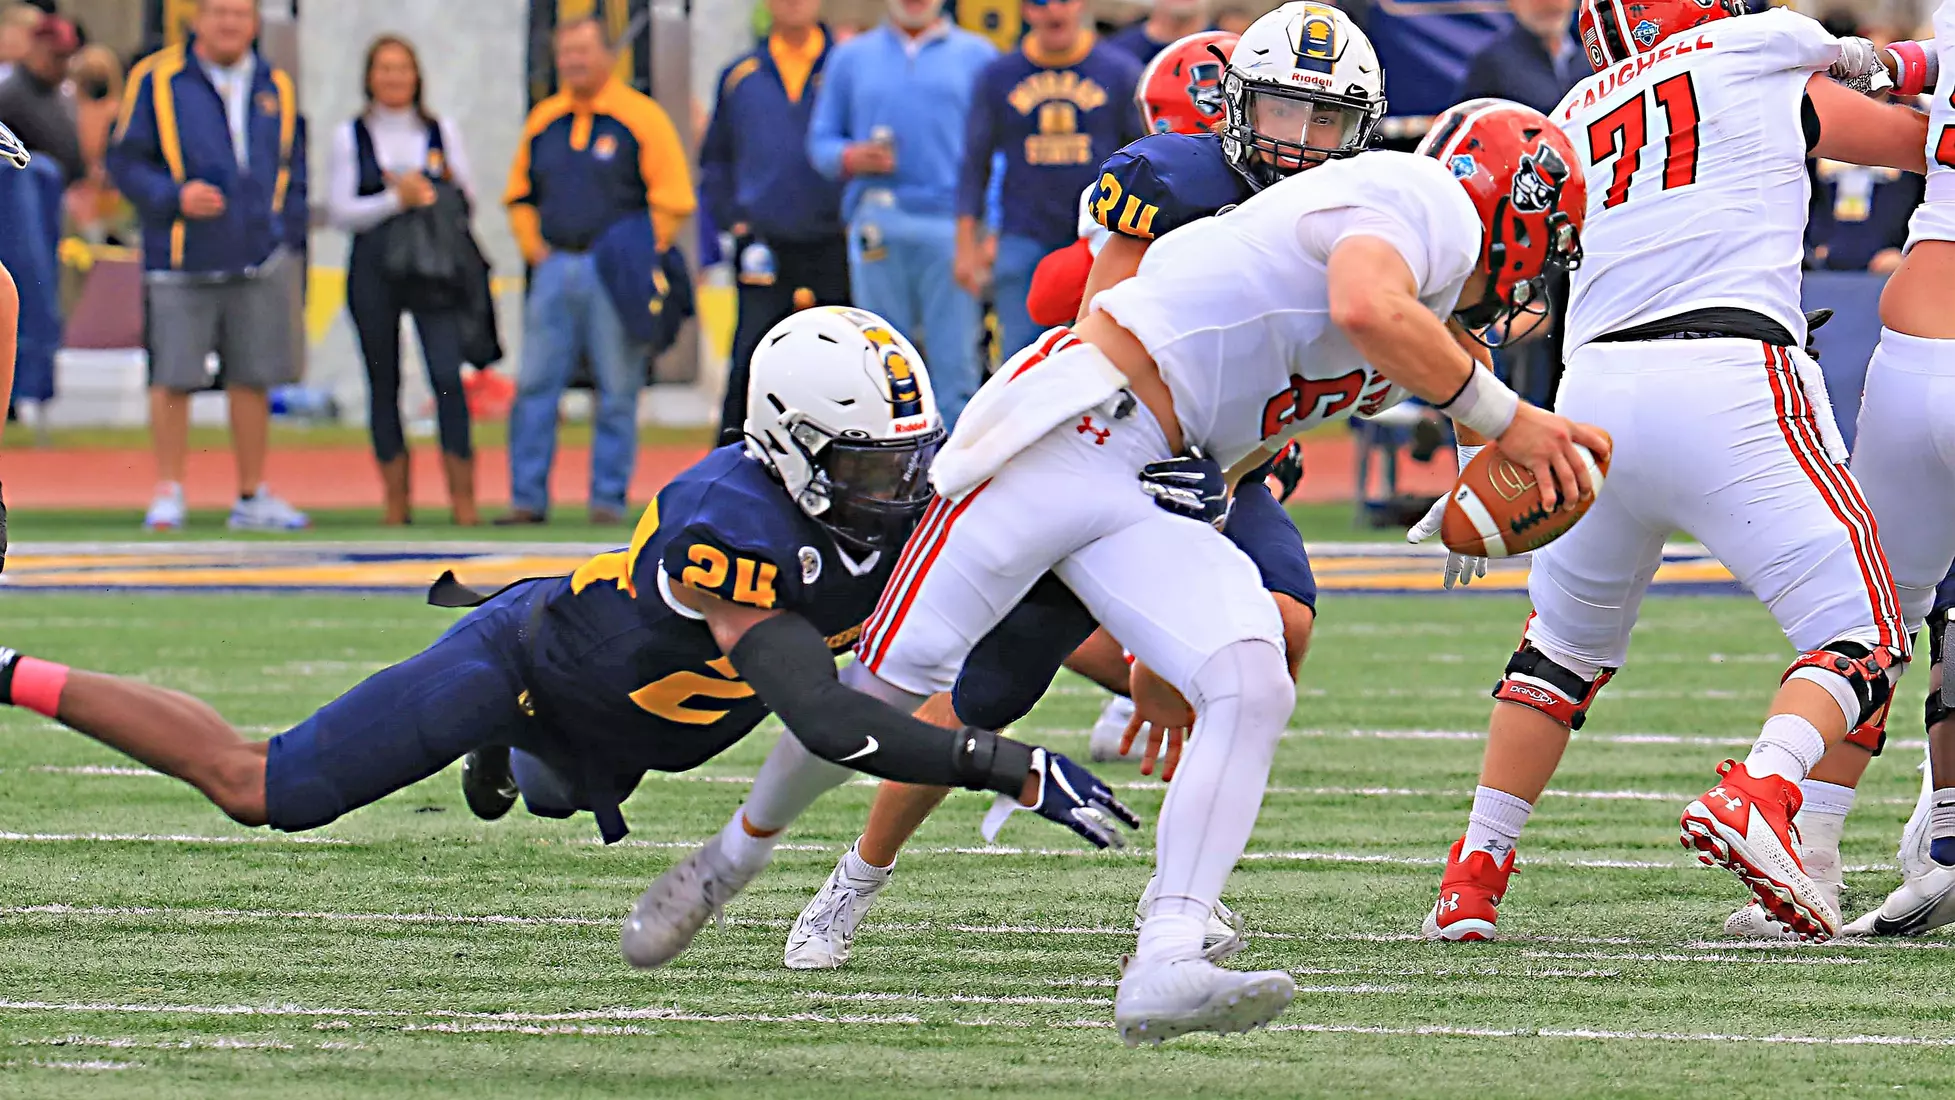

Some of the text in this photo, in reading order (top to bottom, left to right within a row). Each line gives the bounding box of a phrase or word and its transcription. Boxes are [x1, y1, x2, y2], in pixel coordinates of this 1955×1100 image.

[1291, 72, 1333, 88] Riddell
[1586, 70, 1701, 210] 71
[1089, 172, 1160, 240] 34
[682, 543, 778, 609] 24
